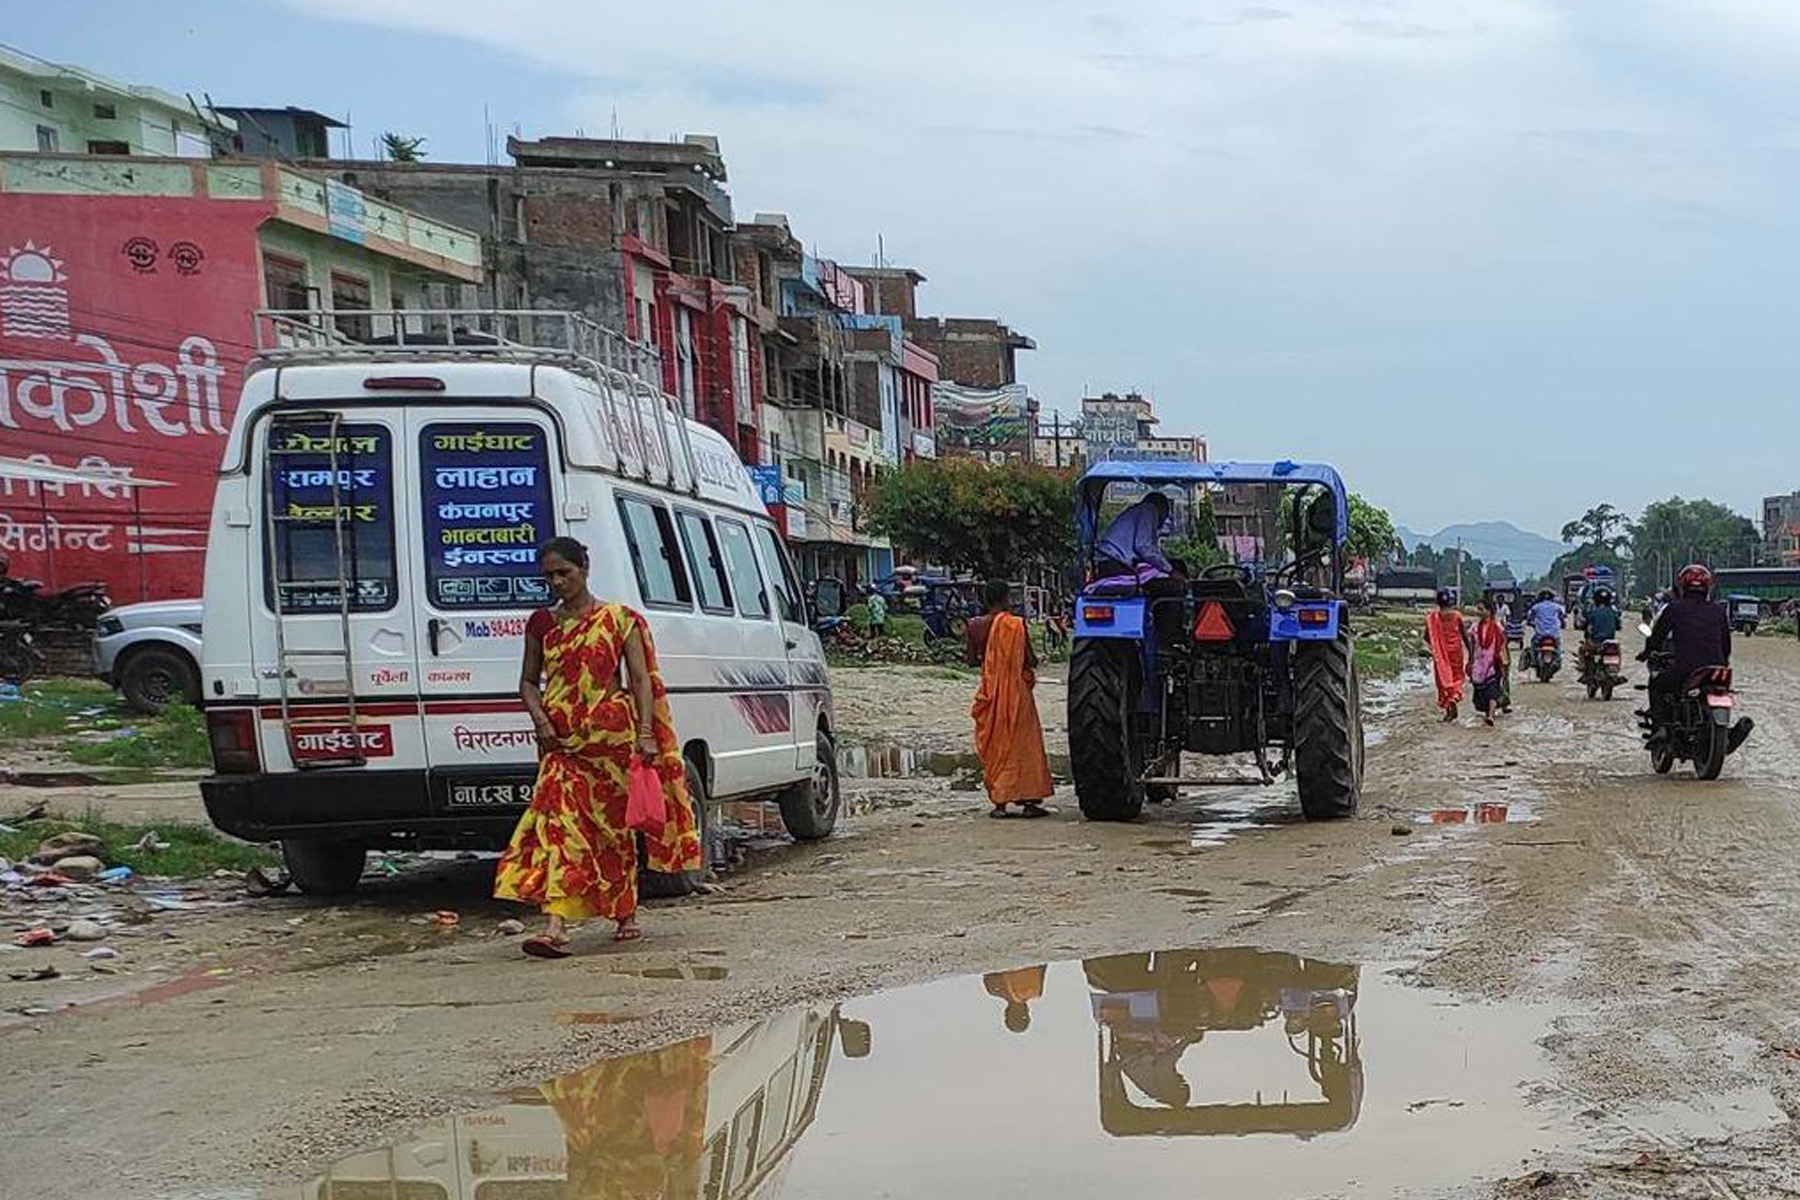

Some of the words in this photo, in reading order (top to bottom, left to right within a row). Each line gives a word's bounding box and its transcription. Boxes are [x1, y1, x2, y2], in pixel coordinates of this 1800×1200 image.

[433, 432, 535, 452] गाईघाट
[435, 466, 537, 489] लाहान
[438, 501, 534, 522] कंचनपुर
